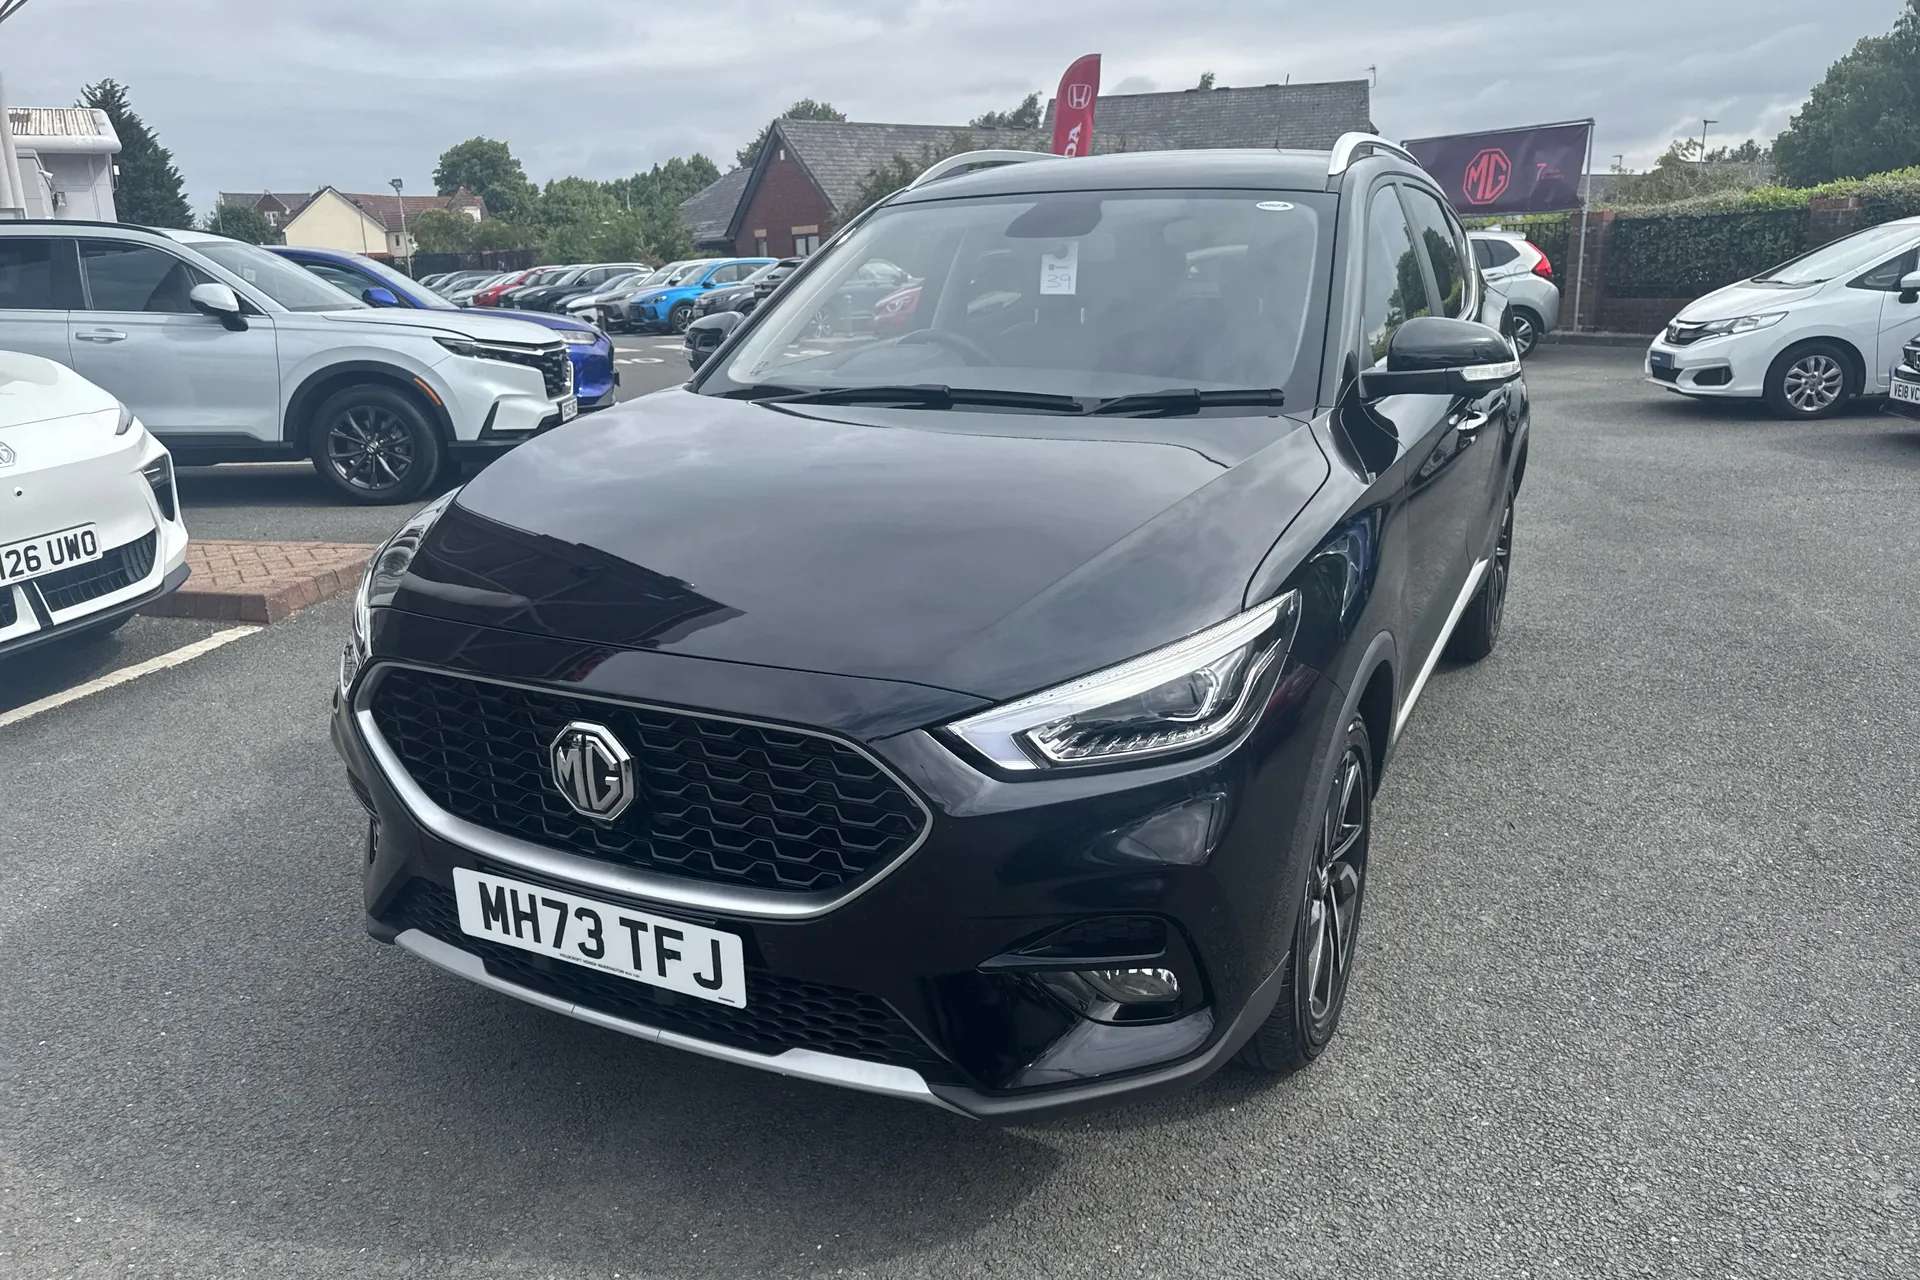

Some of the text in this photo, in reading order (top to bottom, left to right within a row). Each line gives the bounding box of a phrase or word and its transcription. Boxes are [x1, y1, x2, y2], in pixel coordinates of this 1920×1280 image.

[1467, 152, 1507, 200] MG
[0, 530, 97, 580] 26 UWO
[556, 733, 620, 811] MG
[478, 881, 723, 990] MH73 TFJ
